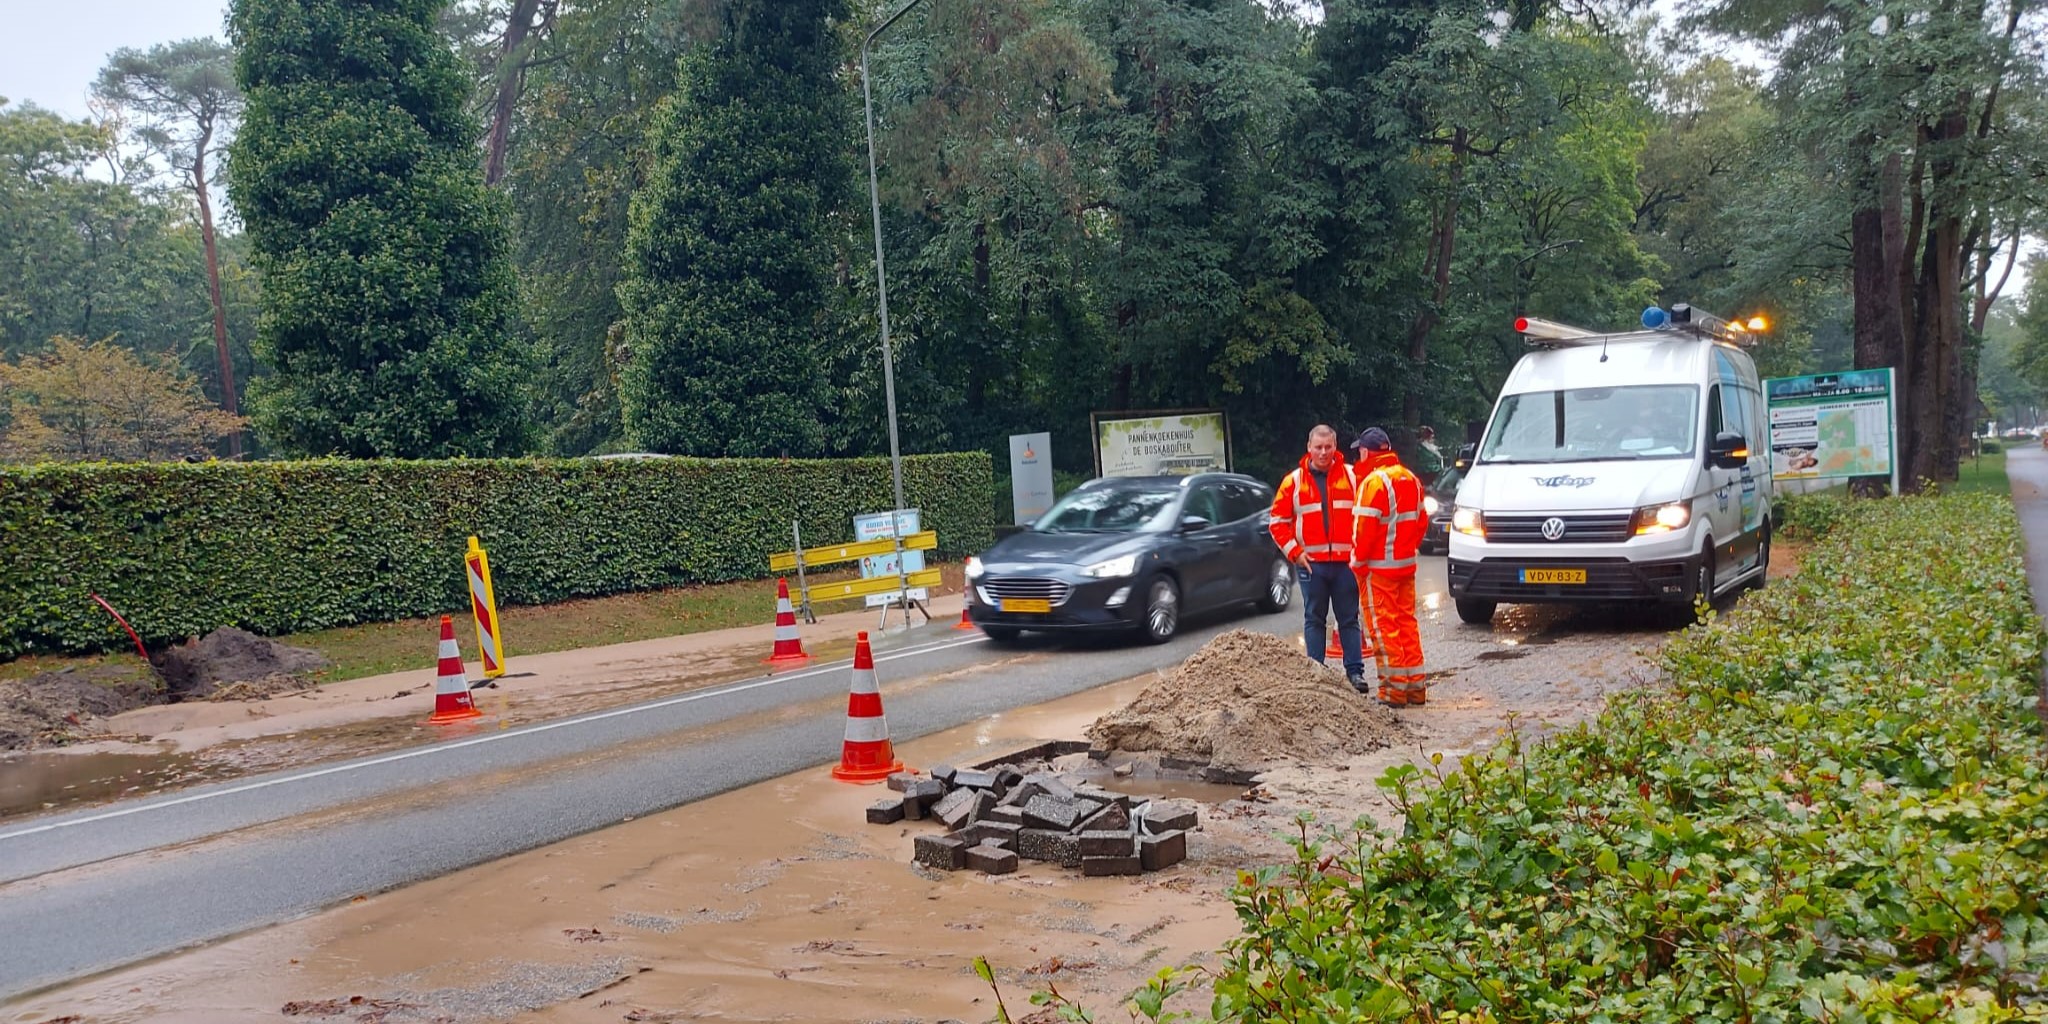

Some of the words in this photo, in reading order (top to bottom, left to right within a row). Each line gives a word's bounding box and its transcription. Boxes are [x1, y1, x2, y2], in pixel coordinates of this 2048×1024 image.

[1128, 429, 1195, 444] PANNENKOEKENHUIS
[1133, 446, 1142, 456] DE
[1144, 441, 1195, 456] BOSKABOUTER
